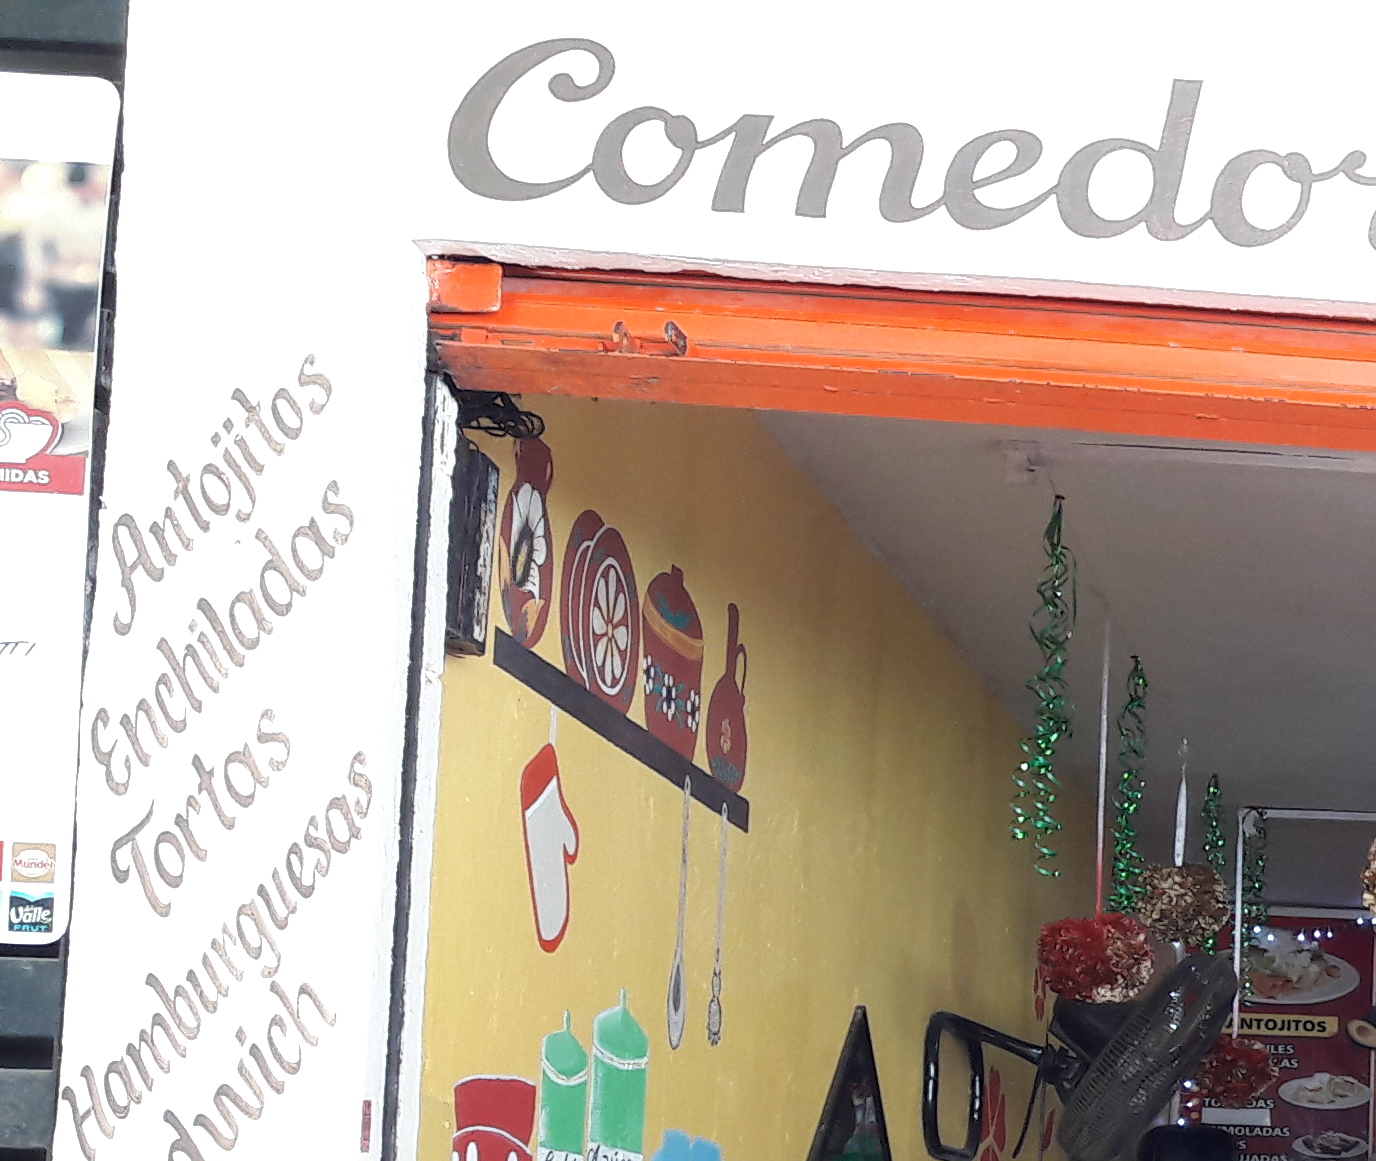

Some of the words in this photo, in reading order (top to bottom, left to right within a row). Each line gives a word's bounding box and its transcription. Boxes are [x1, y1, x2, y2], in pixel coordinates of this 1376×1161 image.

[112, 353, 334, 636] Antojitos
[91, 480, 358, 796] Enchiladas
[110, 708, 291, 918] Tortas
[13, 924, 48, 932] FRUT
[1226, 1017, 1328, 1032] ANTOJITOS
